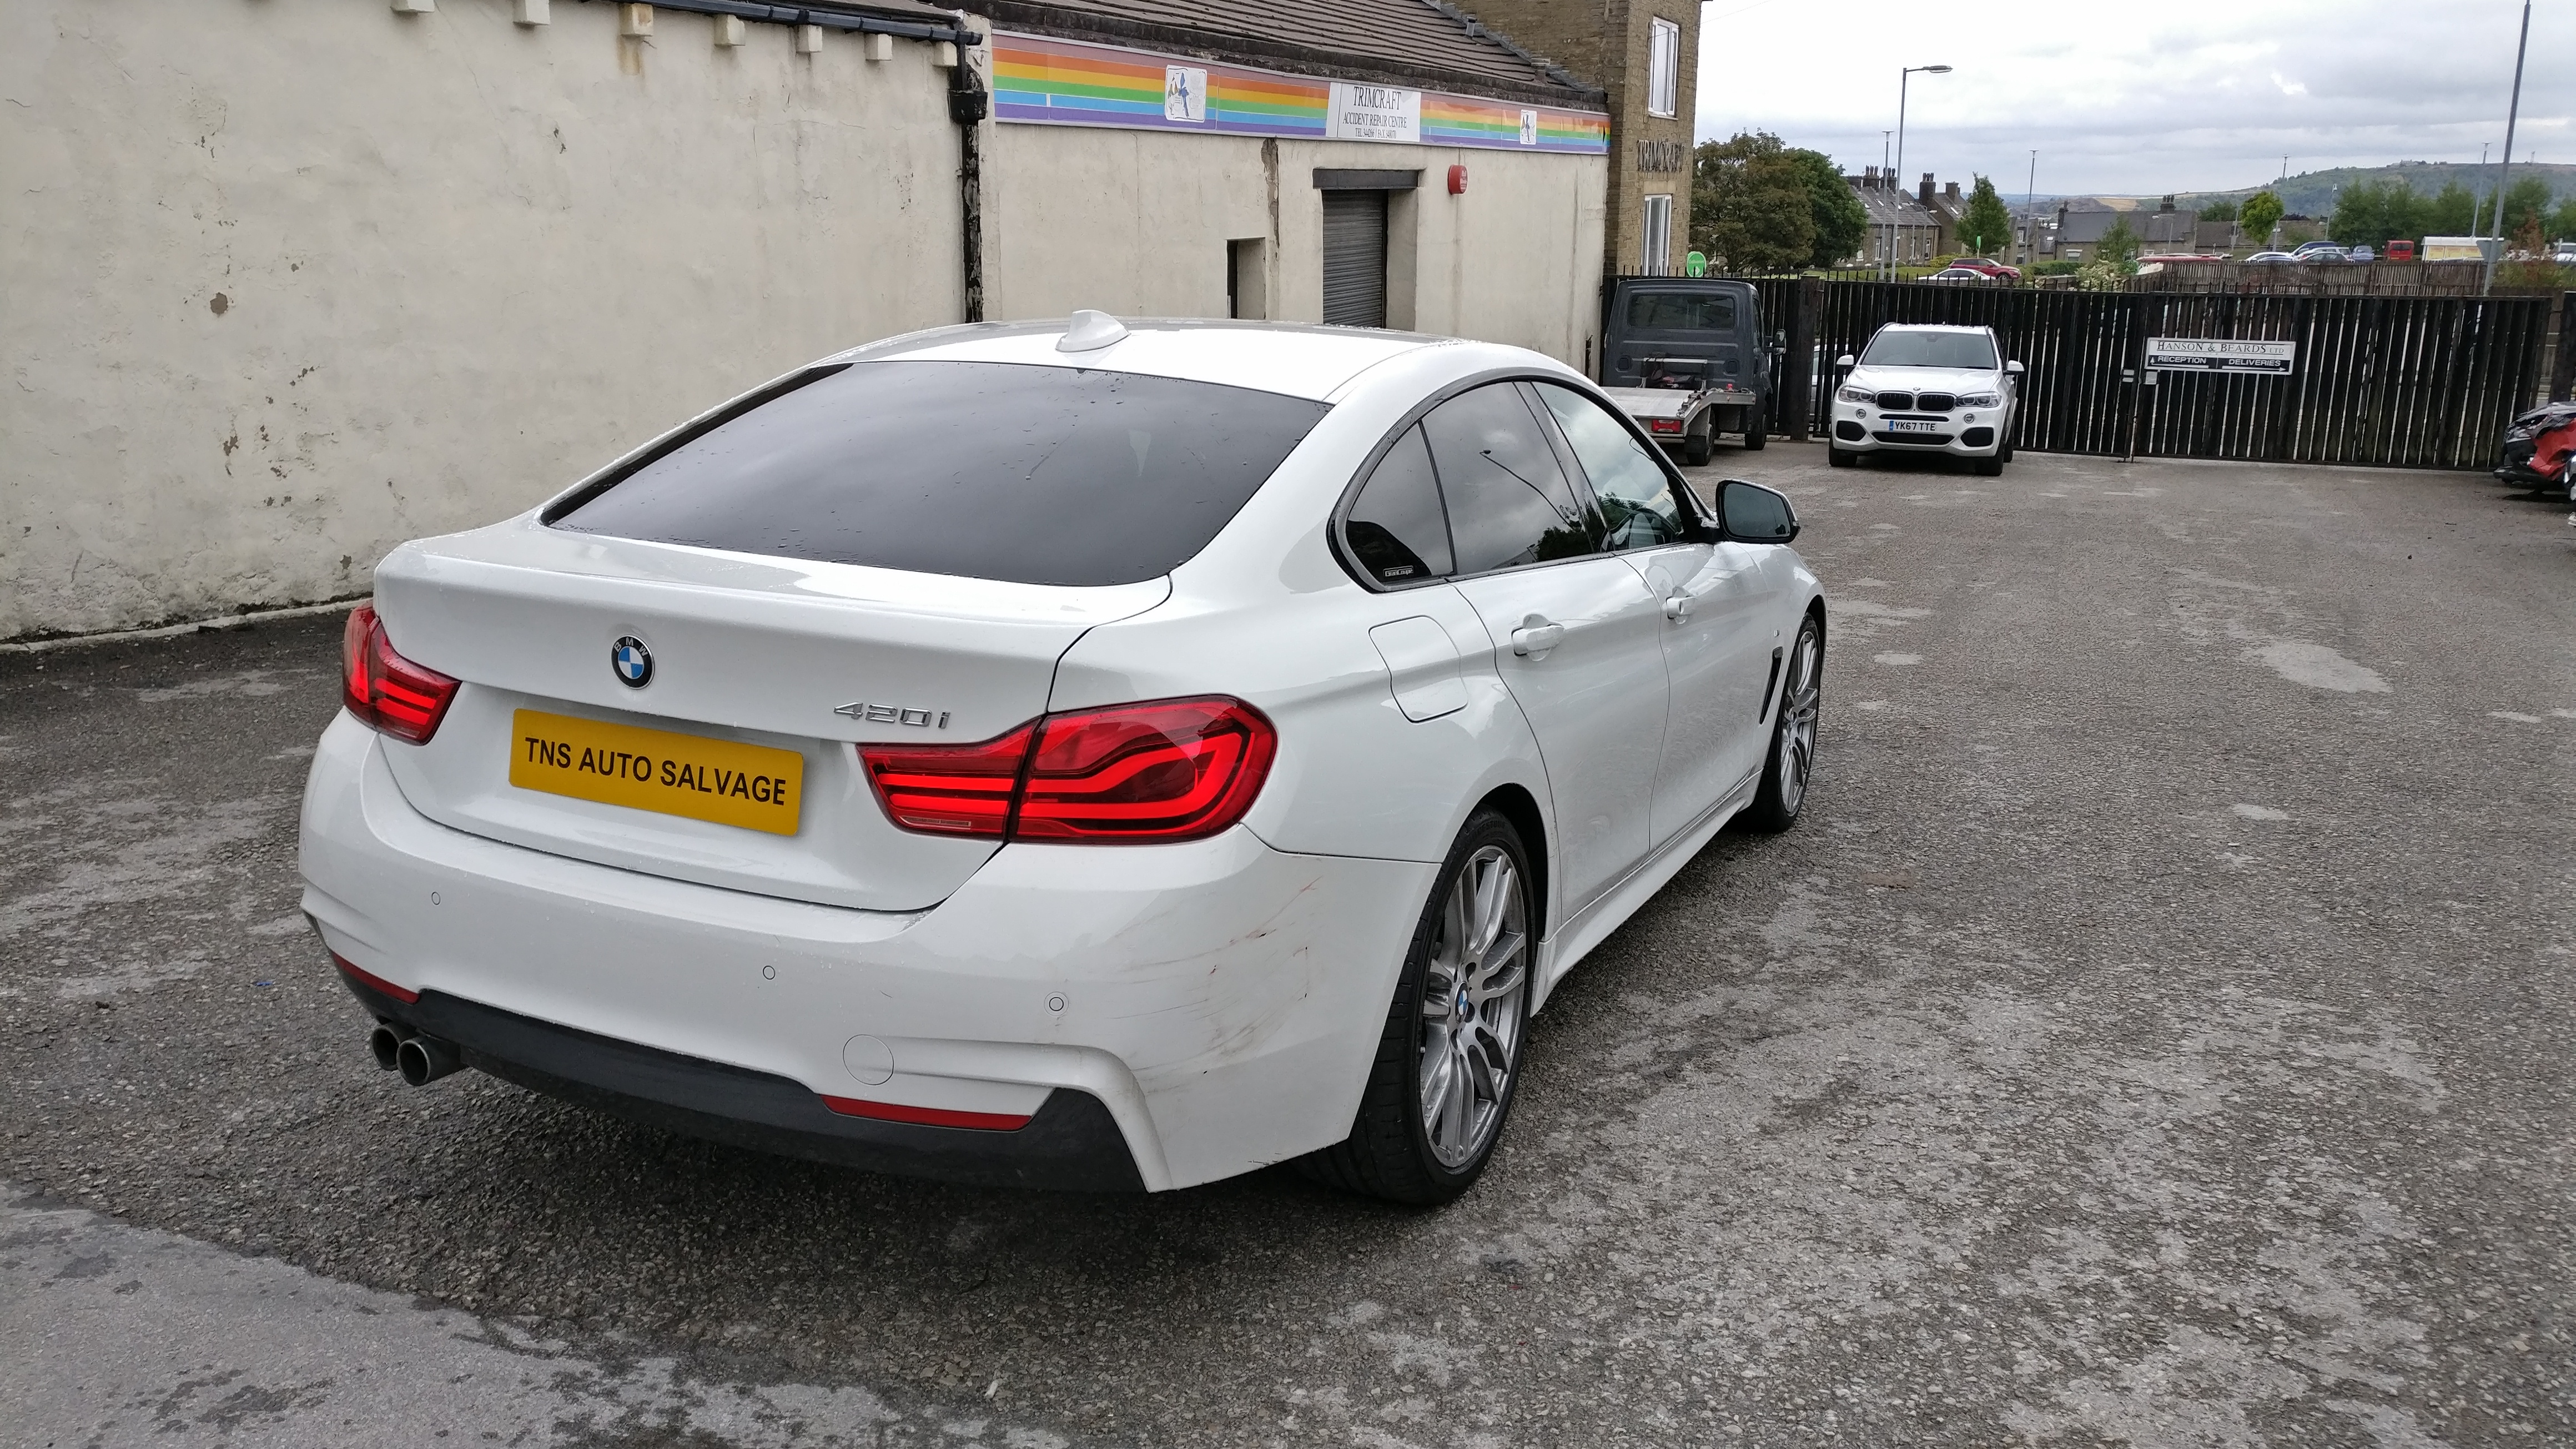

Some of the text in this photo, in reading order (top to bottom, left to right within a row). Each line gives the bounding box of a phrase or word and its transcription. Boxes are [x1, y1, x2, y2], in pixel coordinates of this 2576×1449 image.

[1354, 86, 1401, 110] TRIMCRAFT
[1342, 112, 1407, 128] ACCIDENT REPAIR CENTRE
[2157, 341, 2203, 351] HANSON
[2207, 343, 2216, 351] &
[2221, 344, 2266, 353] BEARDS
[1895, 422, 1917, 430] YK67
[613, 637, 648, 656] BMW
[833, 702, 950, 729] 420i
[525, 737, 786, 806] TNS AUTO SALVAGE
